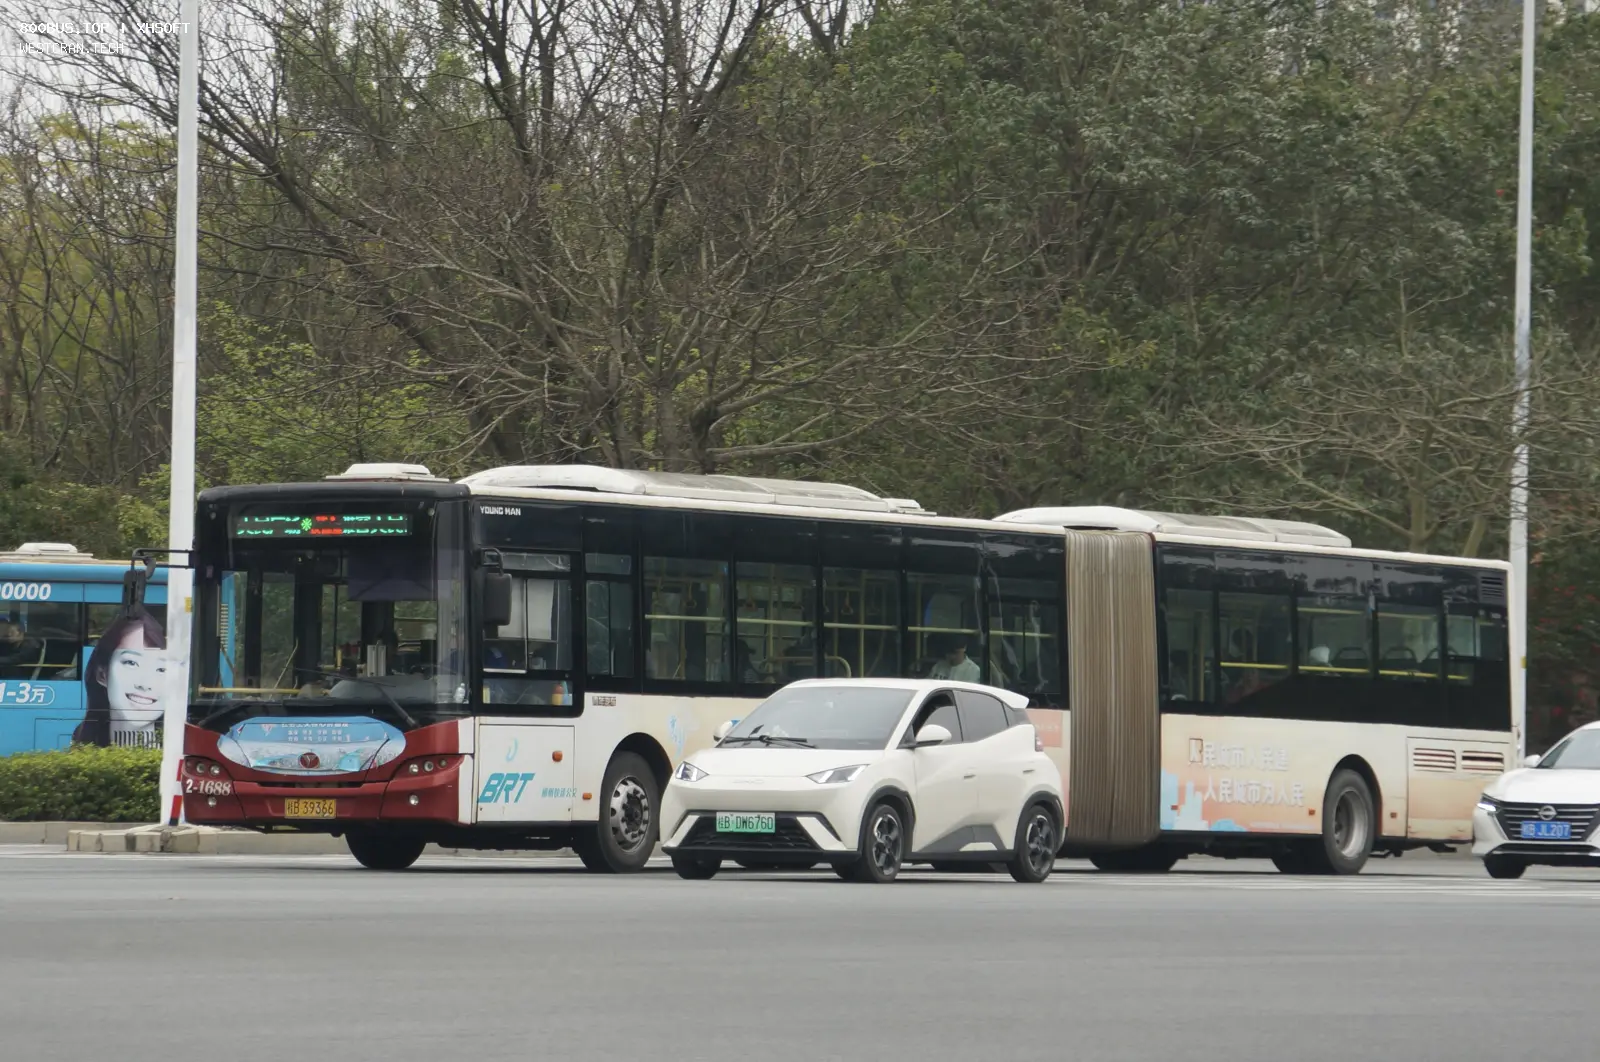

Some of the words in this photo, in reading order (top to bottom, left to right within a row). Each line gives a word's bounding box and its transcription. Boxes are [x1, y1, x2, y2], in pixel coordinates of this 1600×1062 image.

[480, 506, 504, 515] YOUNG
[504, 507, 521, 516] MAN
[0, 582, 52, 600] 0000
[186, 779, 231, 796] 2-1688
[477, 772, 536, 804] BRT
